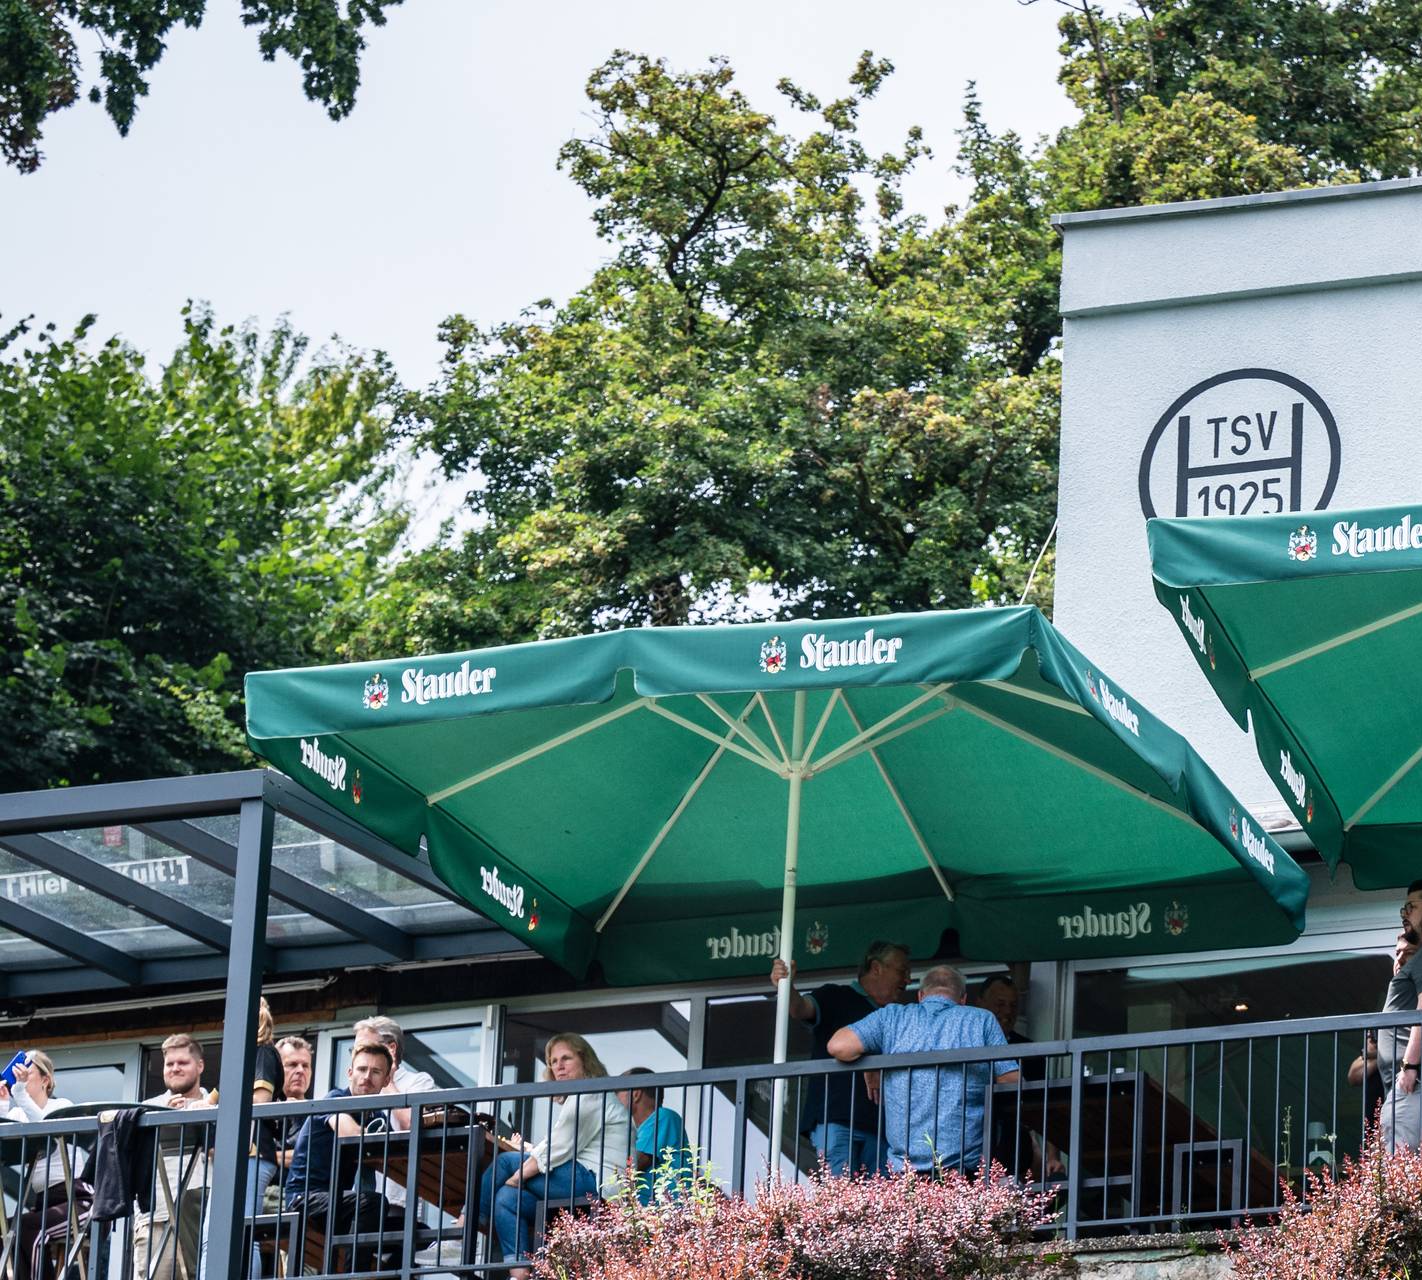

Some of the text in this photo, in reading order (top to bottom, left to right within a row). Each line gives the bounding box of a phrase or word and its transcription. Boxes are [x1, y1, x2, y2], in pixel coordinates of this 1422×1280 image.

[1206, 410, 1278, 459] TSV
[1197, 477, 1284, 517] 1925
[799, 628, 903, 671] Stauder
[400, 660, 497, 704] Stauder
[1098, 678, 1140, 737] Stauder
